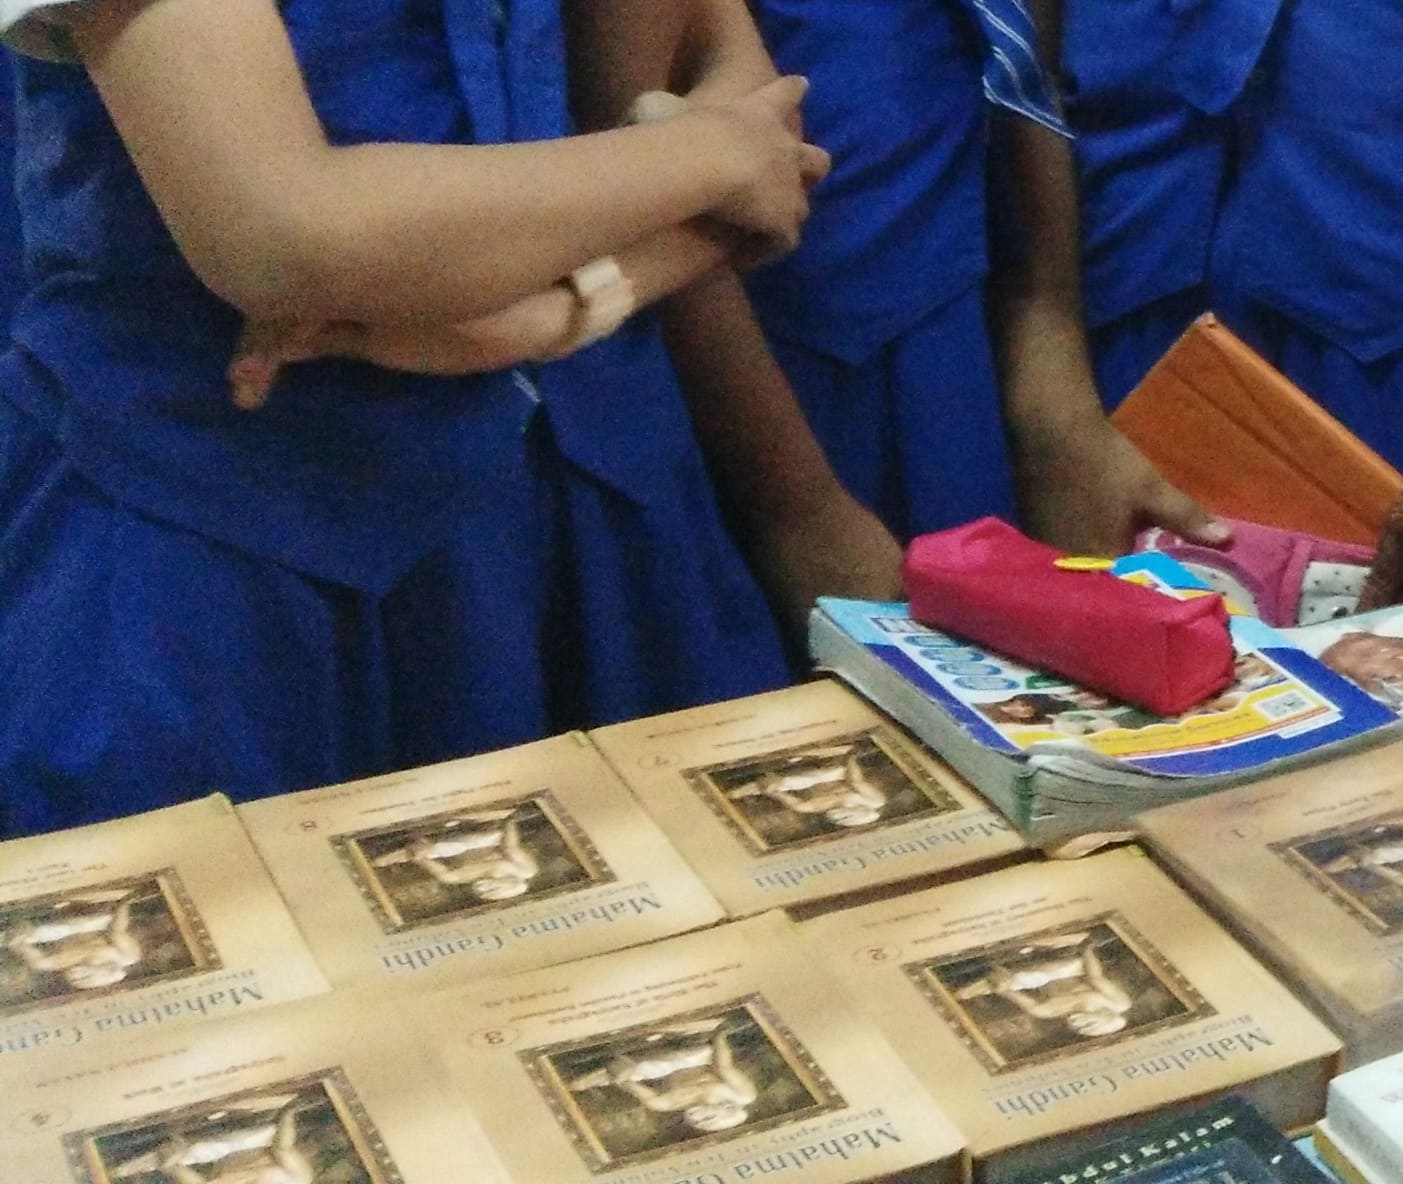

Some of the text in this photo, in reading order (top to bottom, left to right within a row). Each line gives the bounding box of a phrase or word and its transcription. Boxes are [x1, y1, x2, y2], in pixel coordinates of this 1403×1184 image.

[753, 816, 1010, 893] Mahatma Gandhi
[382, 893, 664, 974] Mahatma Gandhi
[870, 949, 886, 961] 2
[0, 981, 266, 1056] Mahatma Gan
[483, 1030, 505, 1046] 3
[995, 1026, 1276, 1121] Mahatma Gandhi
[734, 1121, 904, 1183] Mahatma
[1041, 1152, 1134, 1184] bdul
[1139, 1116, 1235, 1158] Kalam
